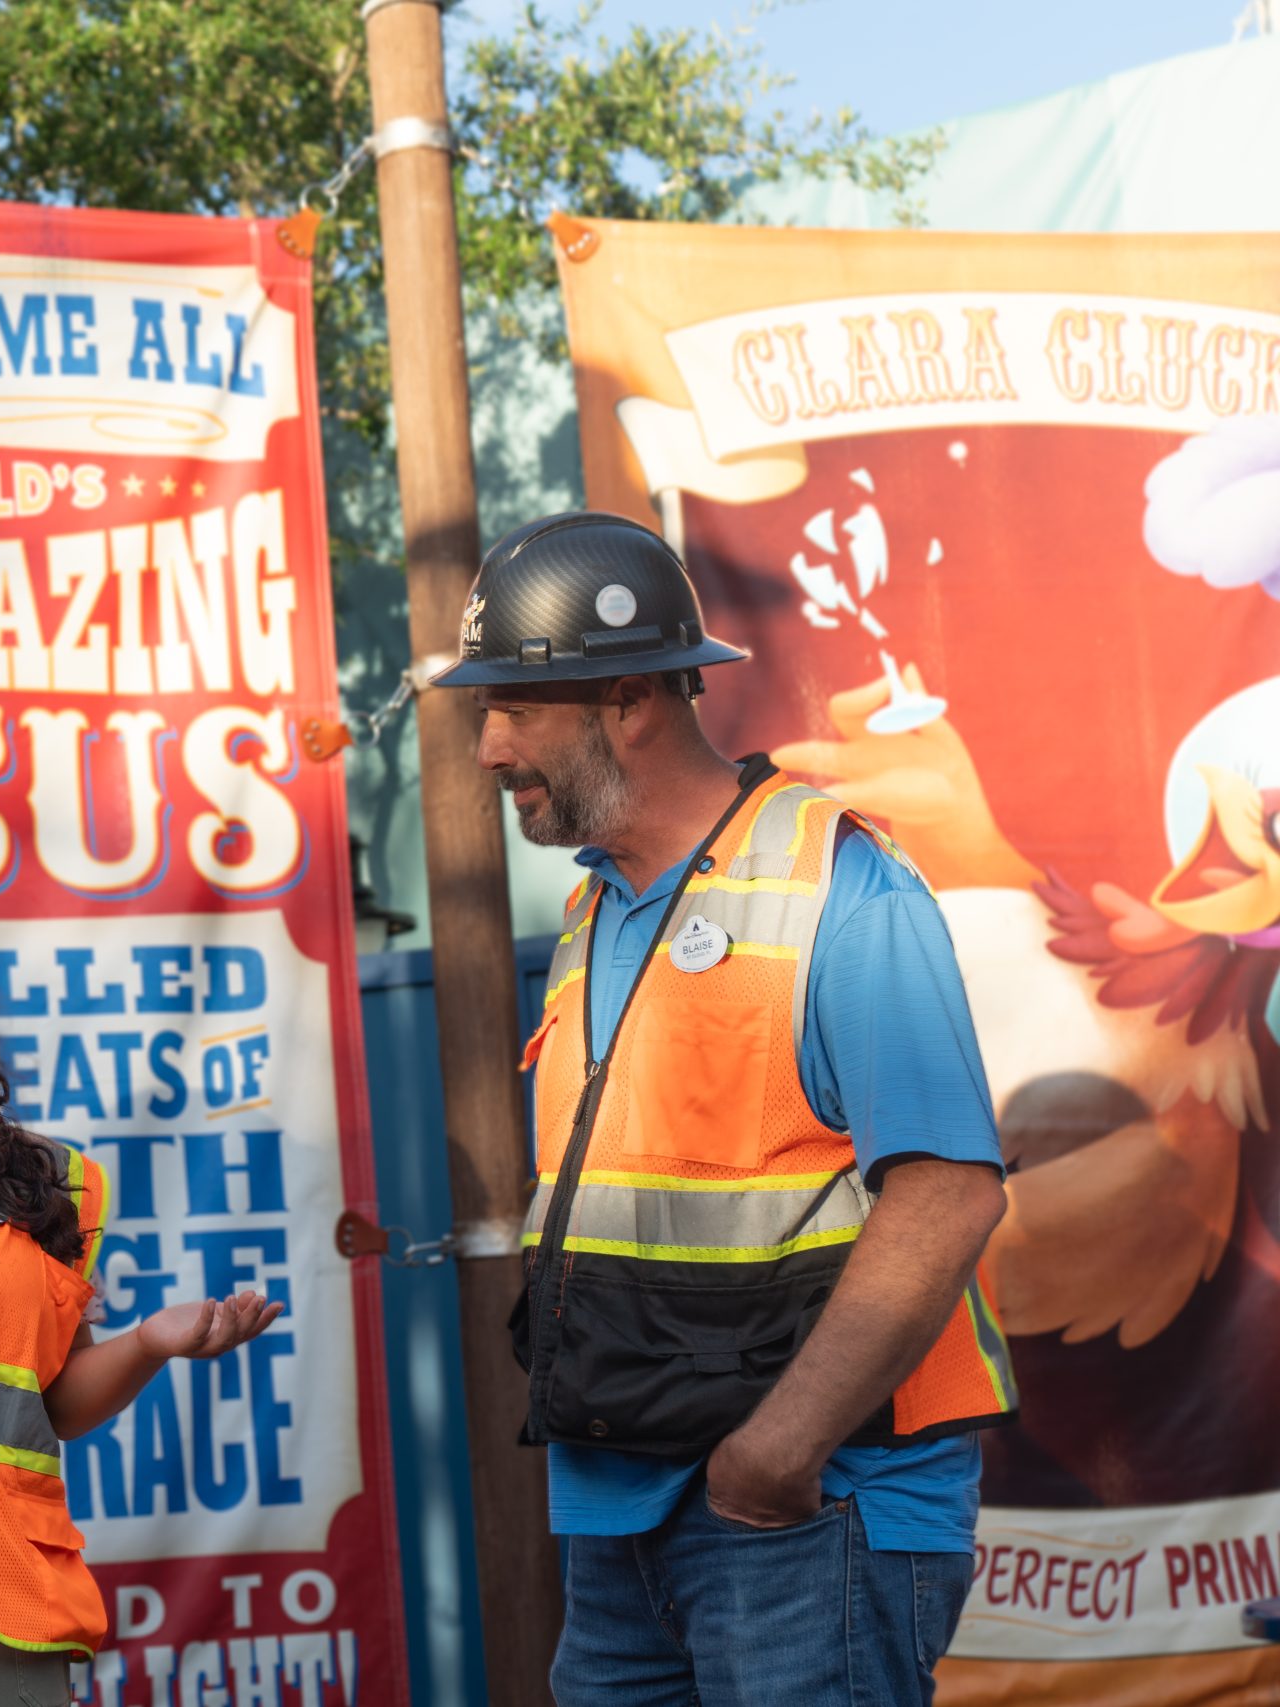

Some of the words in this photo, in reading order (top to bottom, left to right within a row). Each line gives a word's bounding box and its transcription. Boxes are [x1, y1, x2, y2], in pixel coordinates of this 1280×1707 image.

[128, 298, 267, 398] ALL
[733, 306, 1019, 426] CLARA
[462, 623, 482, 641] AM
[683, 940, 713, 954] BLAISE
[202, 1033, 271, 1110] OF
[64, 1331, 304, 1521] RACE
[221, 1569, 337, 1629] TO
[1163, 1530, 1280, 1610] PRIM
